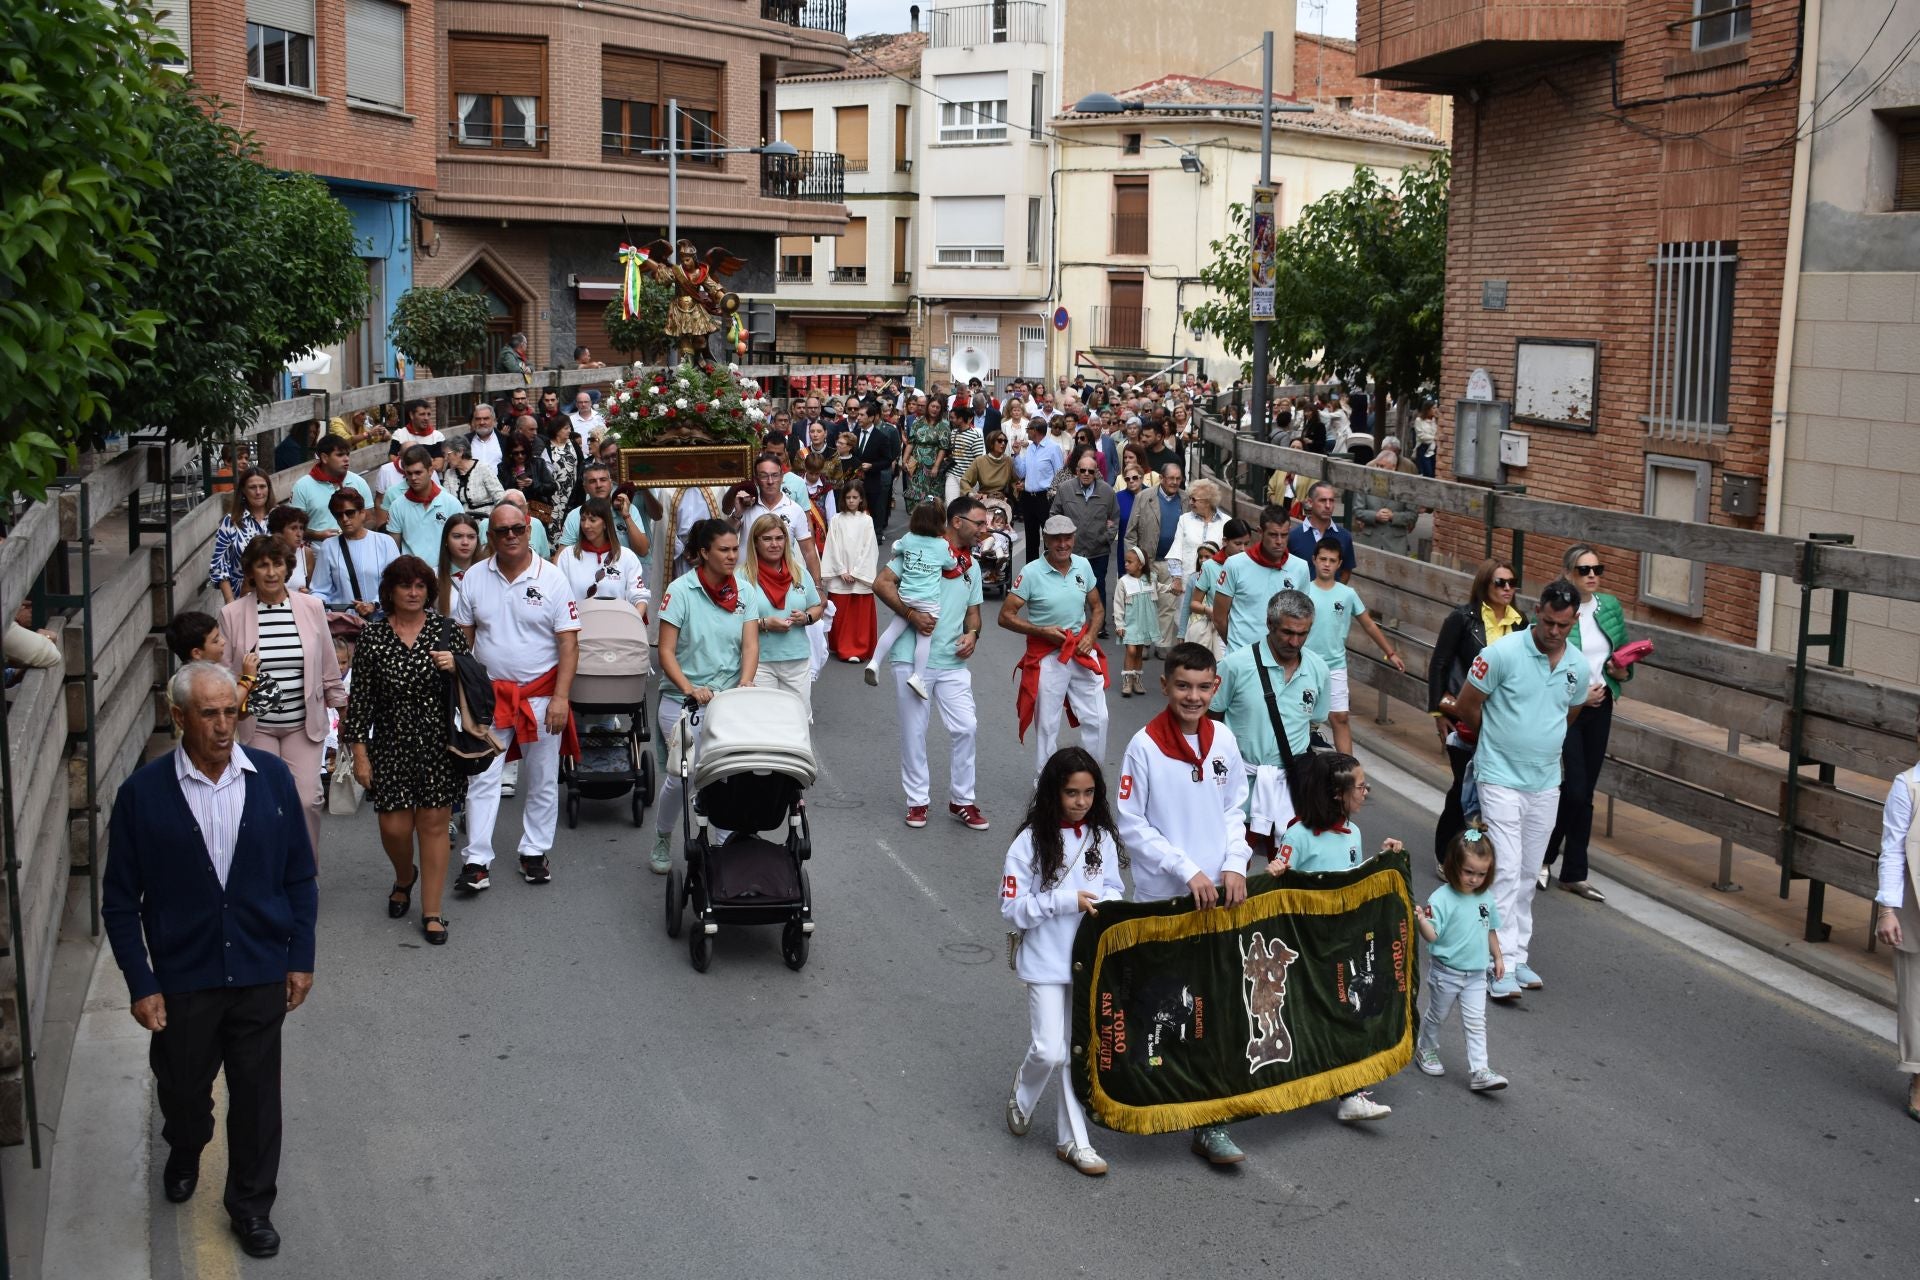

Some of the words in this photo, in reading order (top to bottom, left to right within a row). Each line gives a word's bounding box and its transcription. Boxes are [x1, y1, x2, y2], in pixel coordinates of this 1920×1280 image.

[1471, 656, 1489, 680] 29
[1119, 775, 1132, 800] 9
[1392, 940, 1405, 980] TORO
[1102, 992, 1112, 1016] SAN
[1113, 1009, 1127, 1053] TORO
[1100, 1024, 1113, 1071] MIGUEL
